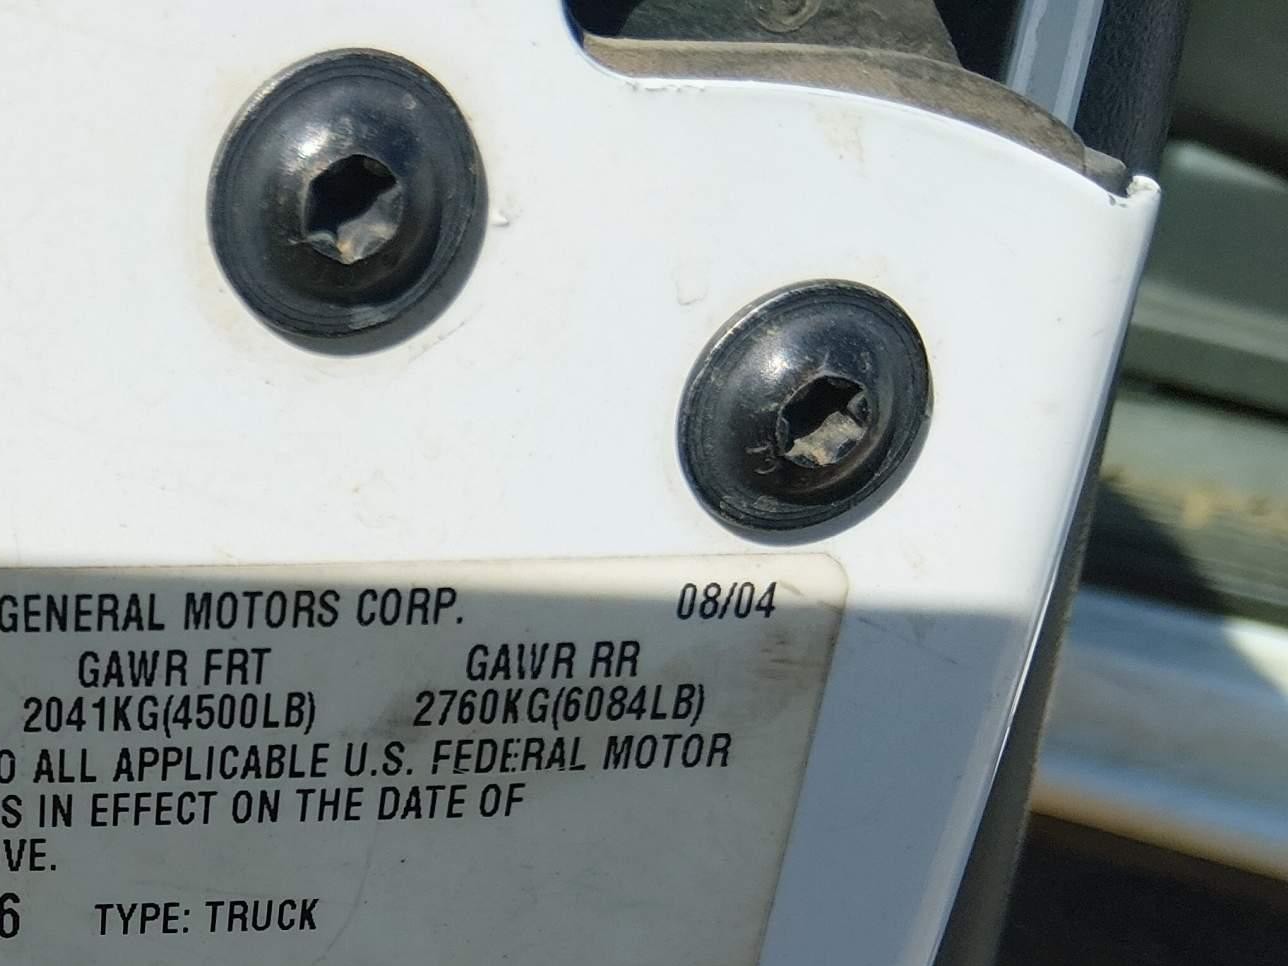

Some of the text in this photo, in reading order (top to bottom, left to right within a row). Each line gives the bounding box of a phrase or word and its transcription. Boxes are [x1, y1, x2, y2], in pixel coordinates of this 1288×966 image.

[184, 590, 339, 630] MOTORS
[357, 588, 464, 626] CORP.
[676, 582, 775, 620] 08/04
[77, 649, 271, 688] GAWR FRT
[466, 641, 640, 681] GAWR RR
[23, 696, 316, 737] 2041KG(4500LB)
[414, 684, 705, 728] 2760KG(6084LB)
[34, 748, 96, 783] ALL
[113, 743, 329, 782] APPLICABLE
[344, 742, 412, 778] U.S.
[433, 737, 586, 775] FEDERAL
[604, 734, 731, 770] MOTOR
[39, 794, 72, 828] IN
[91, 792, 217, 827] EFFECT
[233, 789, 279, 824] ON
[295, 787, 361, 822] THE
[377, 785, 464, 820] DATE
[478, 782, 525, 817] OF
[95, 899, 319, 936] TYPE: TRUCK
